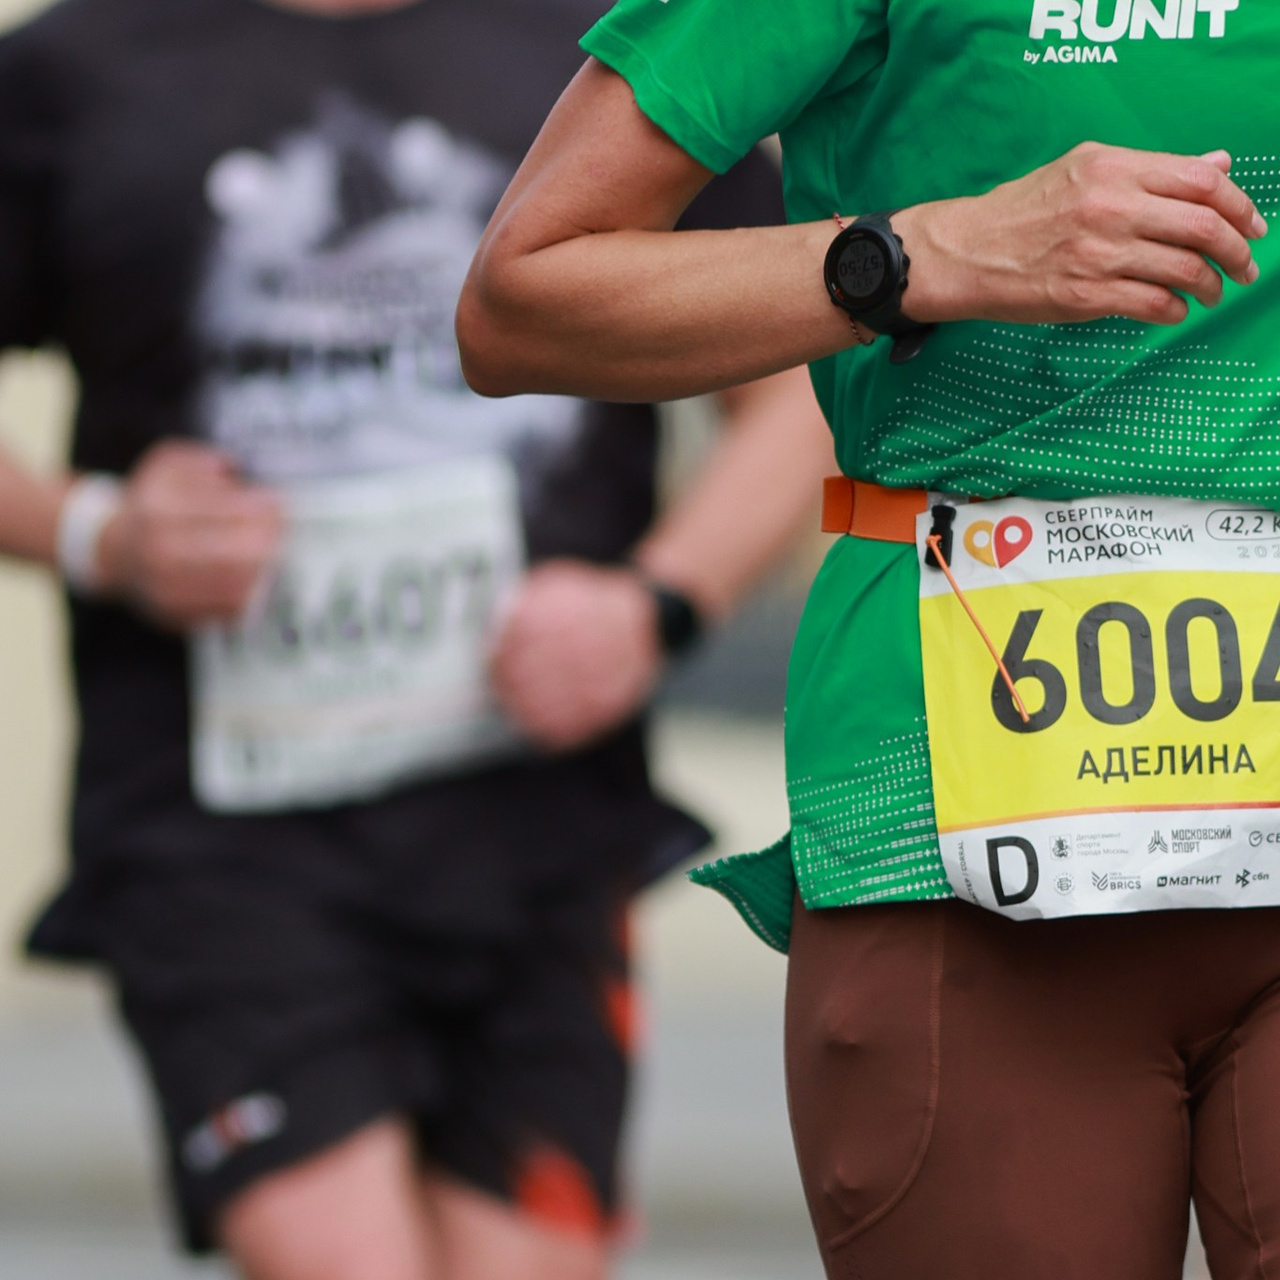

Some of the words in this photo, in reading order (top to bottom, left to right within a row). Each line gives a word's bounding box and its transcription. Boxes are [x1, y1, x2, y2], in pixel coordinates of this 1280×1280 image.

[1023, 49, 1041, 65] by
[1042, 45, 1118, 63] AGIMA
[1045, 505, 1154, 524] СБЕРПРАЙМ
[1046, 523, 1194, 544] МОСКОВСКИЙ
[1219, 515, 1264, 536] 42,2
[1048, 541, 1163, 564] МАРАФОН
[1076, 743, 1257, 784] АДЕЛИНА
[1171, 825, 1232, 841] МОСКОВСКИЙ
[1172, 841, 1200, 854] СПОРТ
[986, 835, 1039, 907] D
[1110, 879, 1142, 891] BRICS
